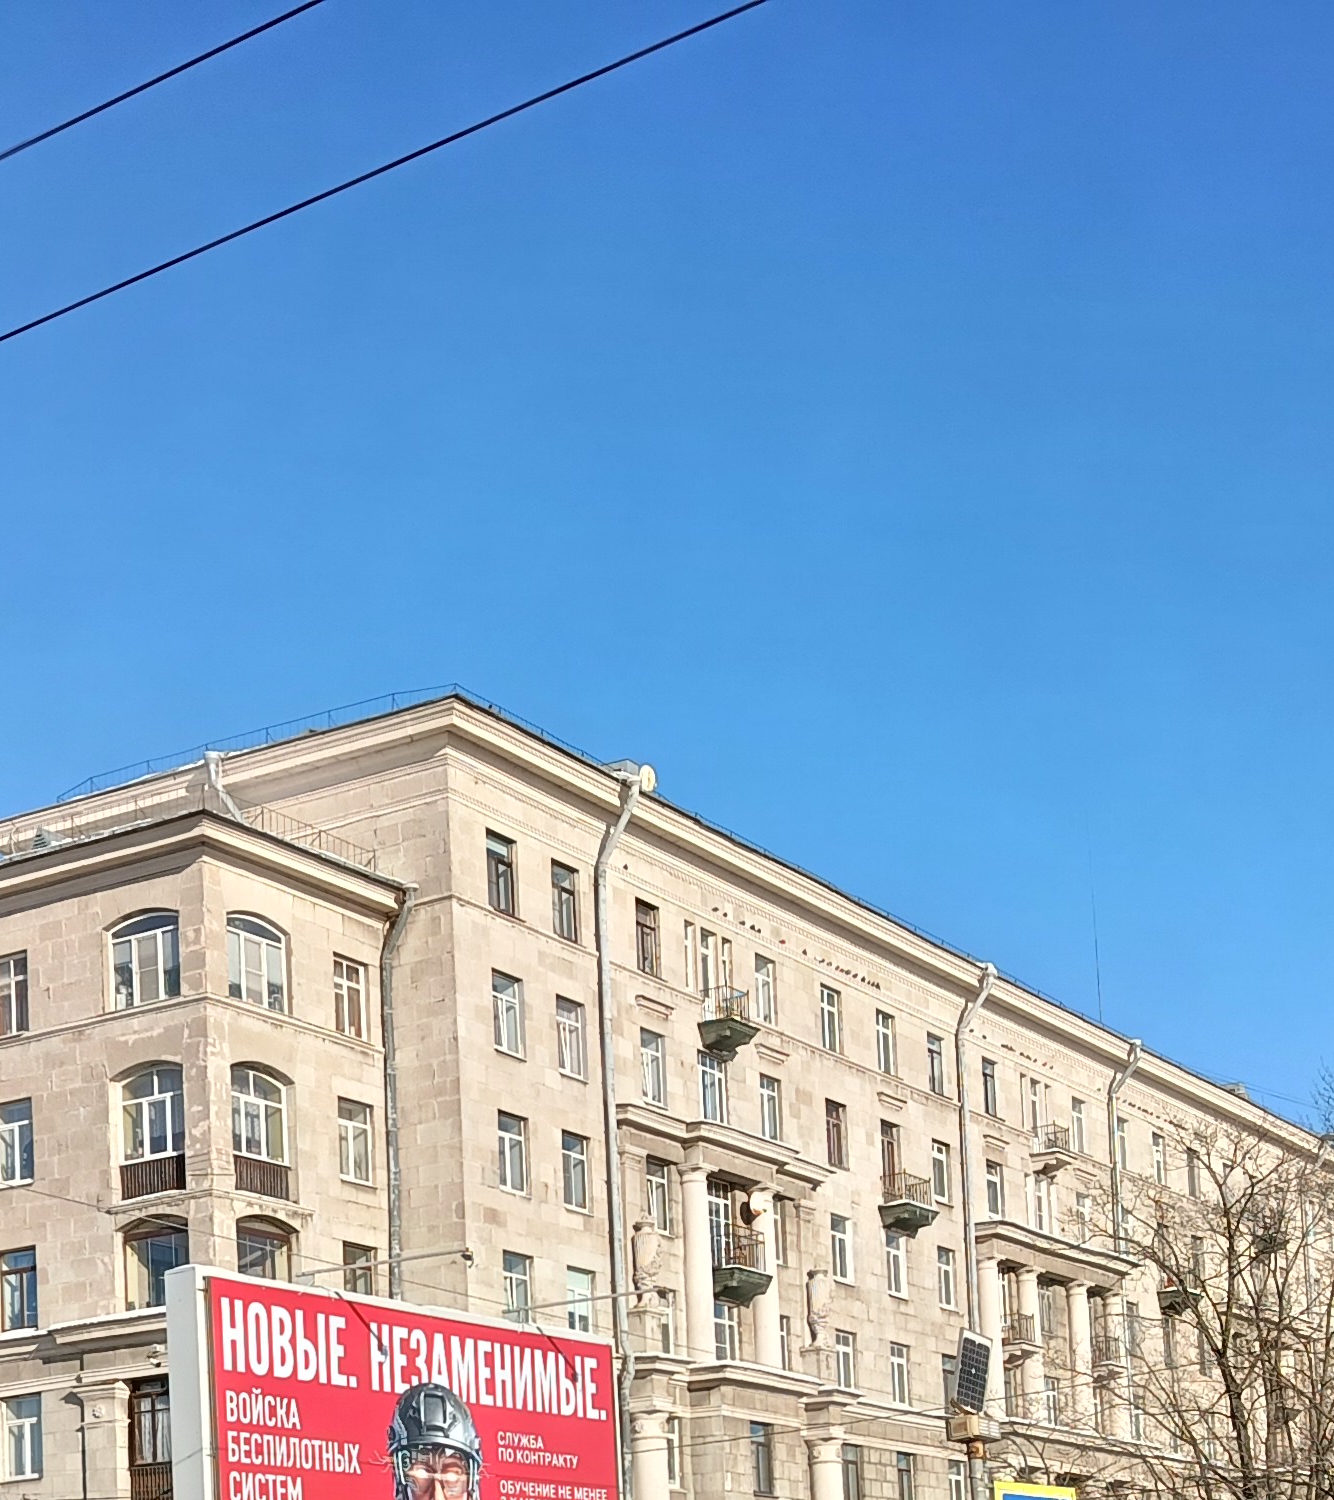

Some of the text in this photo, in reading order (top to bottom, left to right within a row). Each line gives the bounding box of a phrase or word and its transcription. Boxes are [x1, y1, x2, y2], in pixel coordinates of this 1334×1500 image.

[220, 1296, 607, 1421] НОВЫЕ. НЕЗАМЕНИМЫЕ.
[225, 1387, 301, 1430] ВОЙСКА
[227, 1430, 361, 1474] БЕСПИЛОТНЫХ
[497, 1431, 544, 1449] СЛУЖБА
[498, 1447, 578, 1469] ПО КОНТРАКТУ
[499, 1480, 556, 1498] ОБУЧЕНИЕ
[558, 1485, 572, 1499] НЕ
